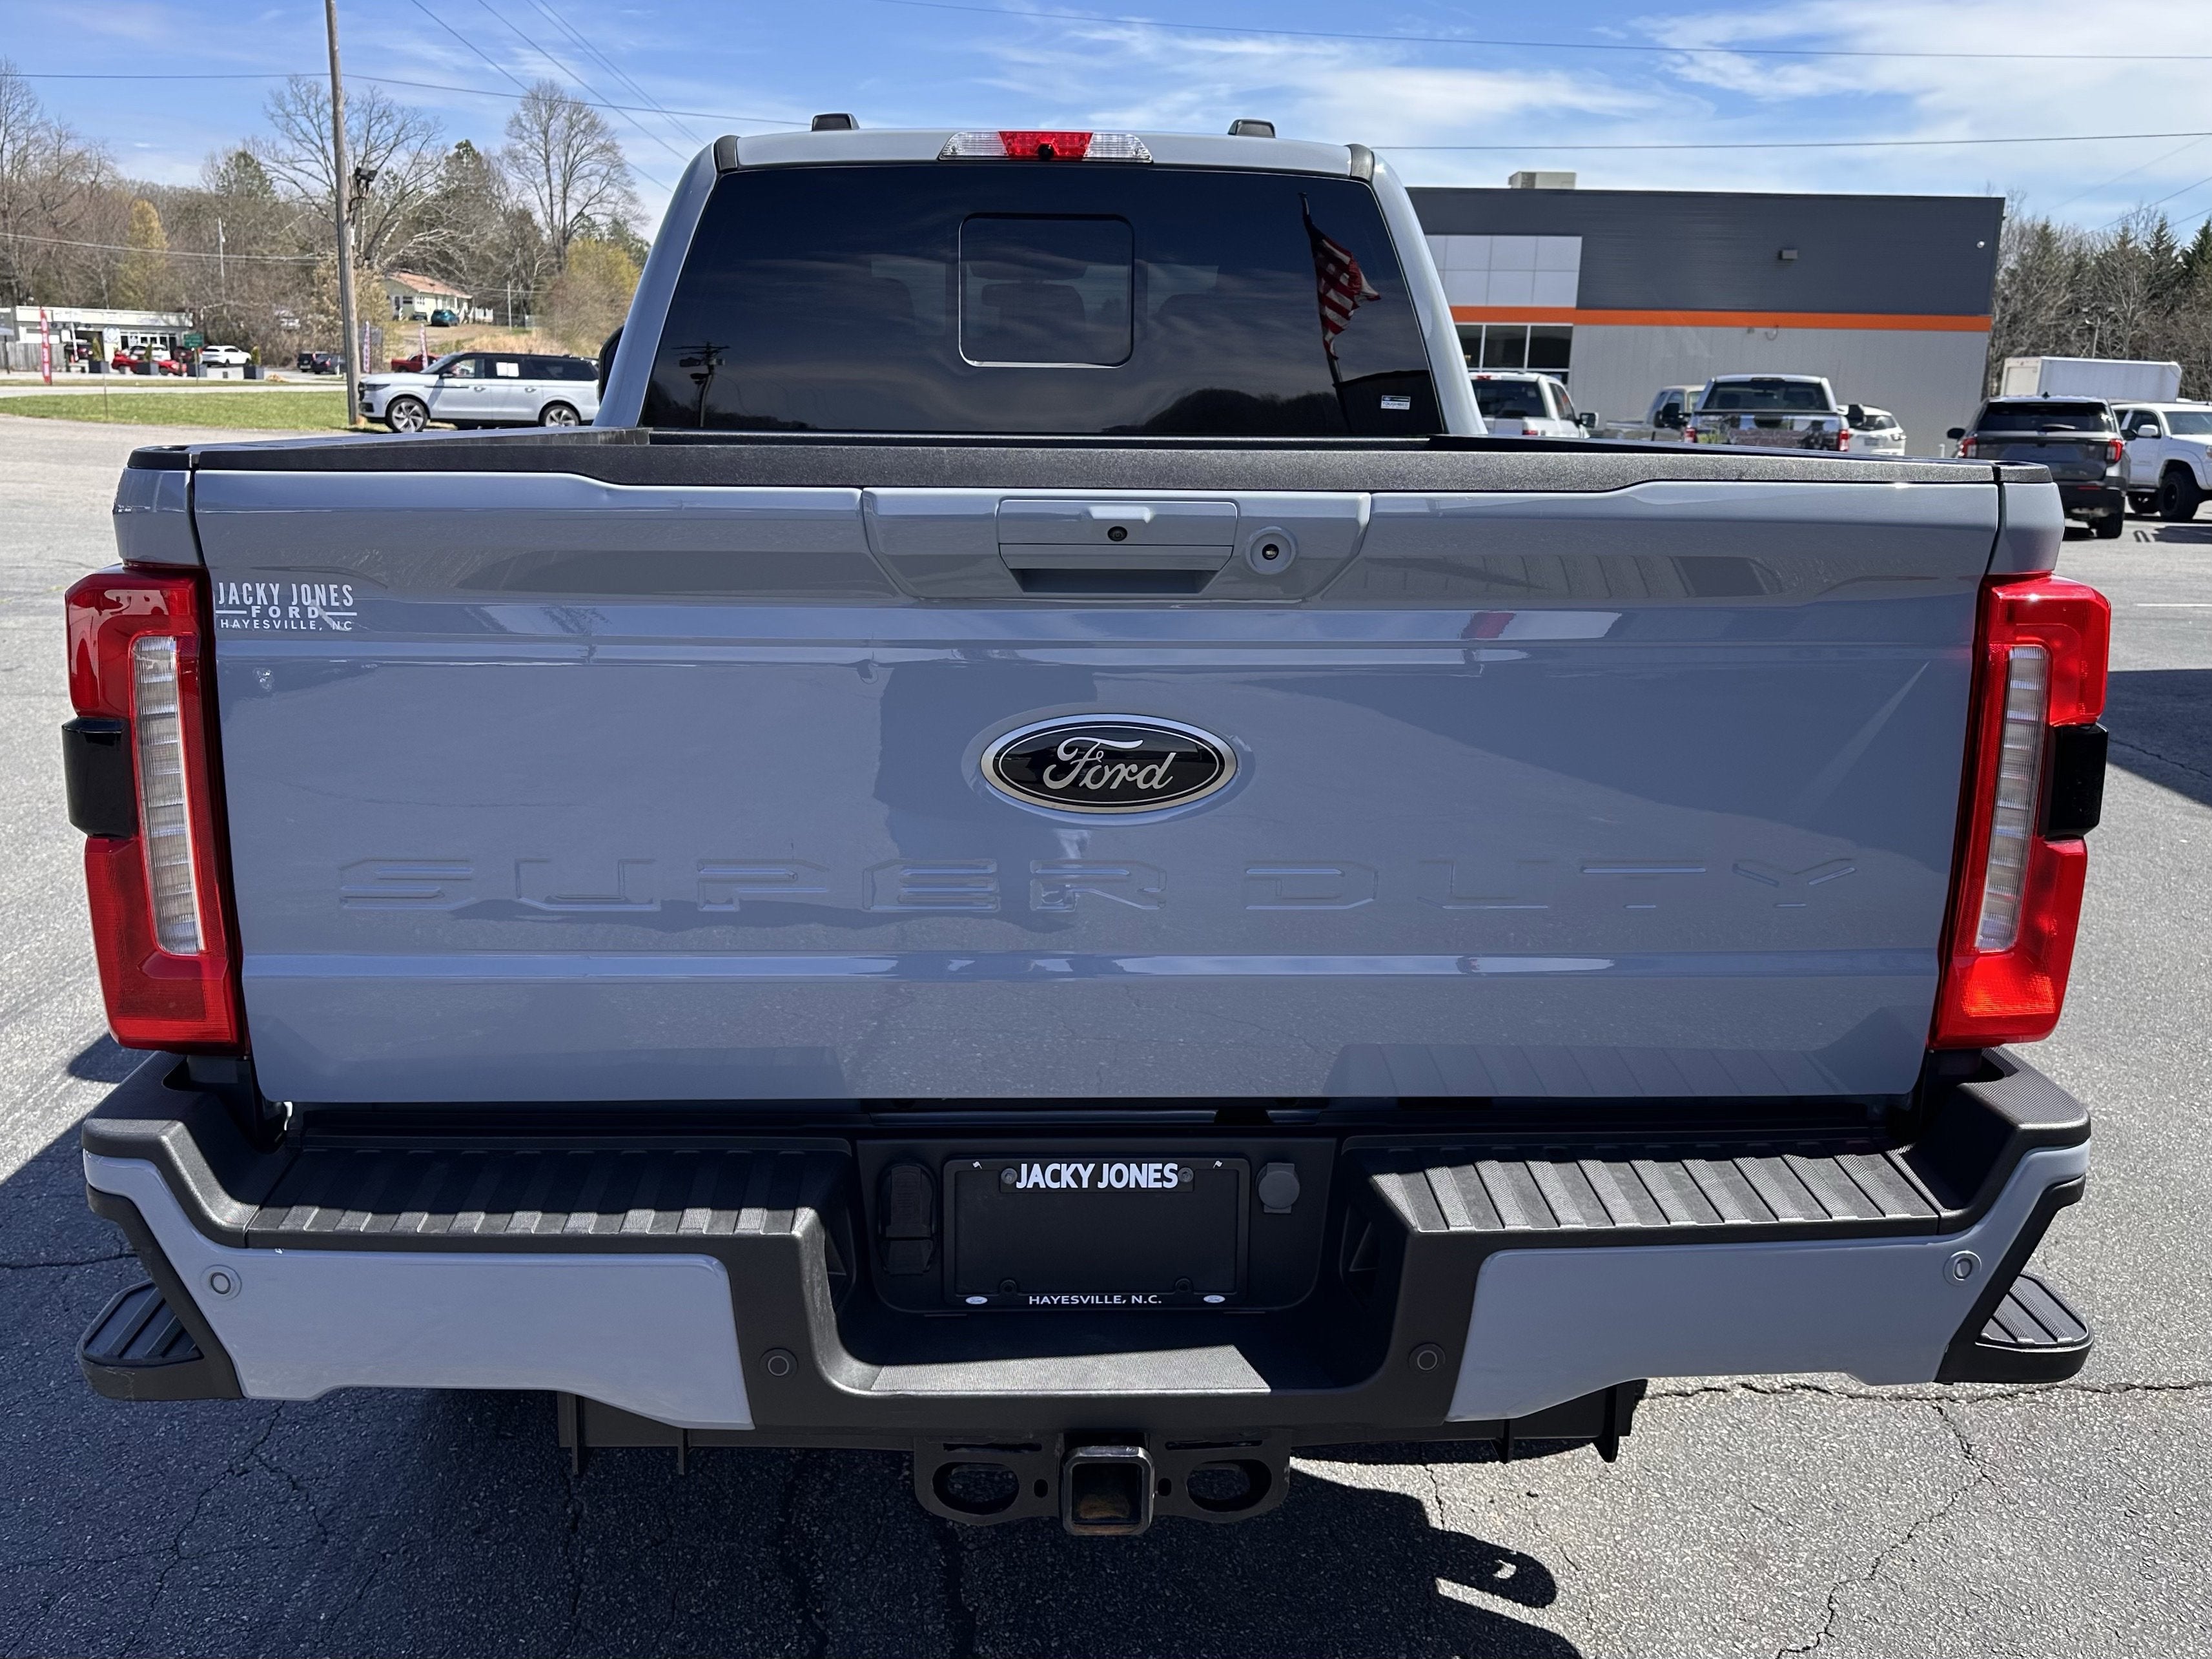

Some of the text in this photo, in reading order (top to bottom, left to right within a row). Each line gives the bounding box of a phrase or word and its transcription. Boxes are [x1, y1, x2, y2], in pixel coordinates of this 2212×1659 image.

[218, 582, 354, 607] JACKY JONES
[251, 605, 320, 619] FORD
[220, 619, 353, 631] HAYESVILLE, NC
[1043, 736, 1177, 790] Ford
[339, 858, 1857, 912] SUPER DUTY
[1016, 1162, 1179, 1189] JACKY JONES
[1029, 1294, 1162, 1304] HAYESVILLE, N.C.
